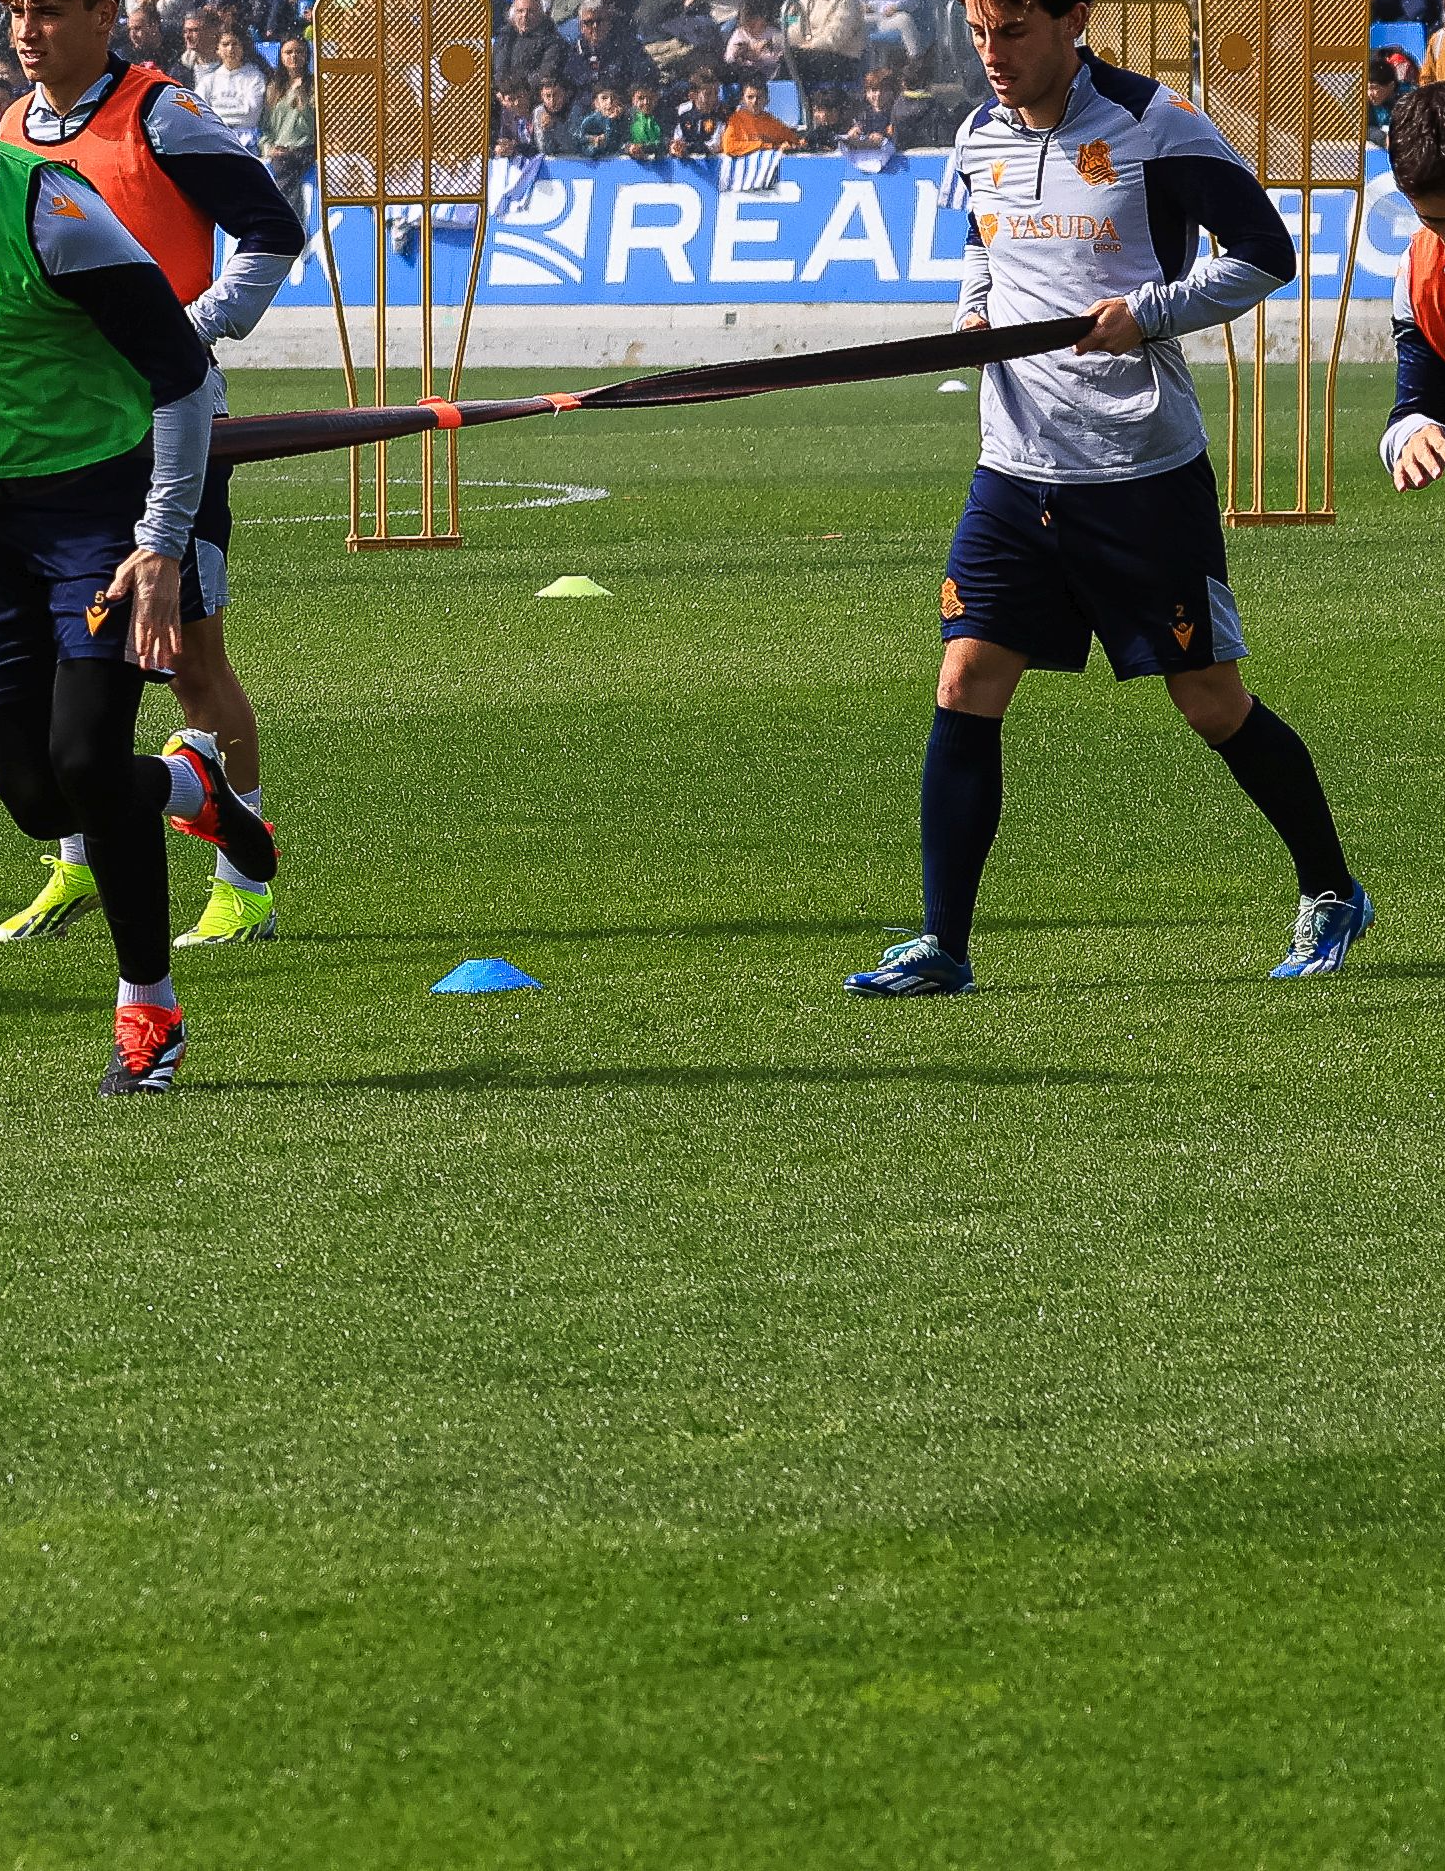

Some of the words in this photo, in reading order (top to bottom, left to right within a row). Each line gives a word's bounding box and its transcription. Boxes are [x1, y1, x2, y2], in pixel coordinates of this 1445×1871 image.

[1006, 215, 1121, 241] YASUDA
[1093, 243, 1122, 255] group
[1176, 604, 1185, 617] 2
